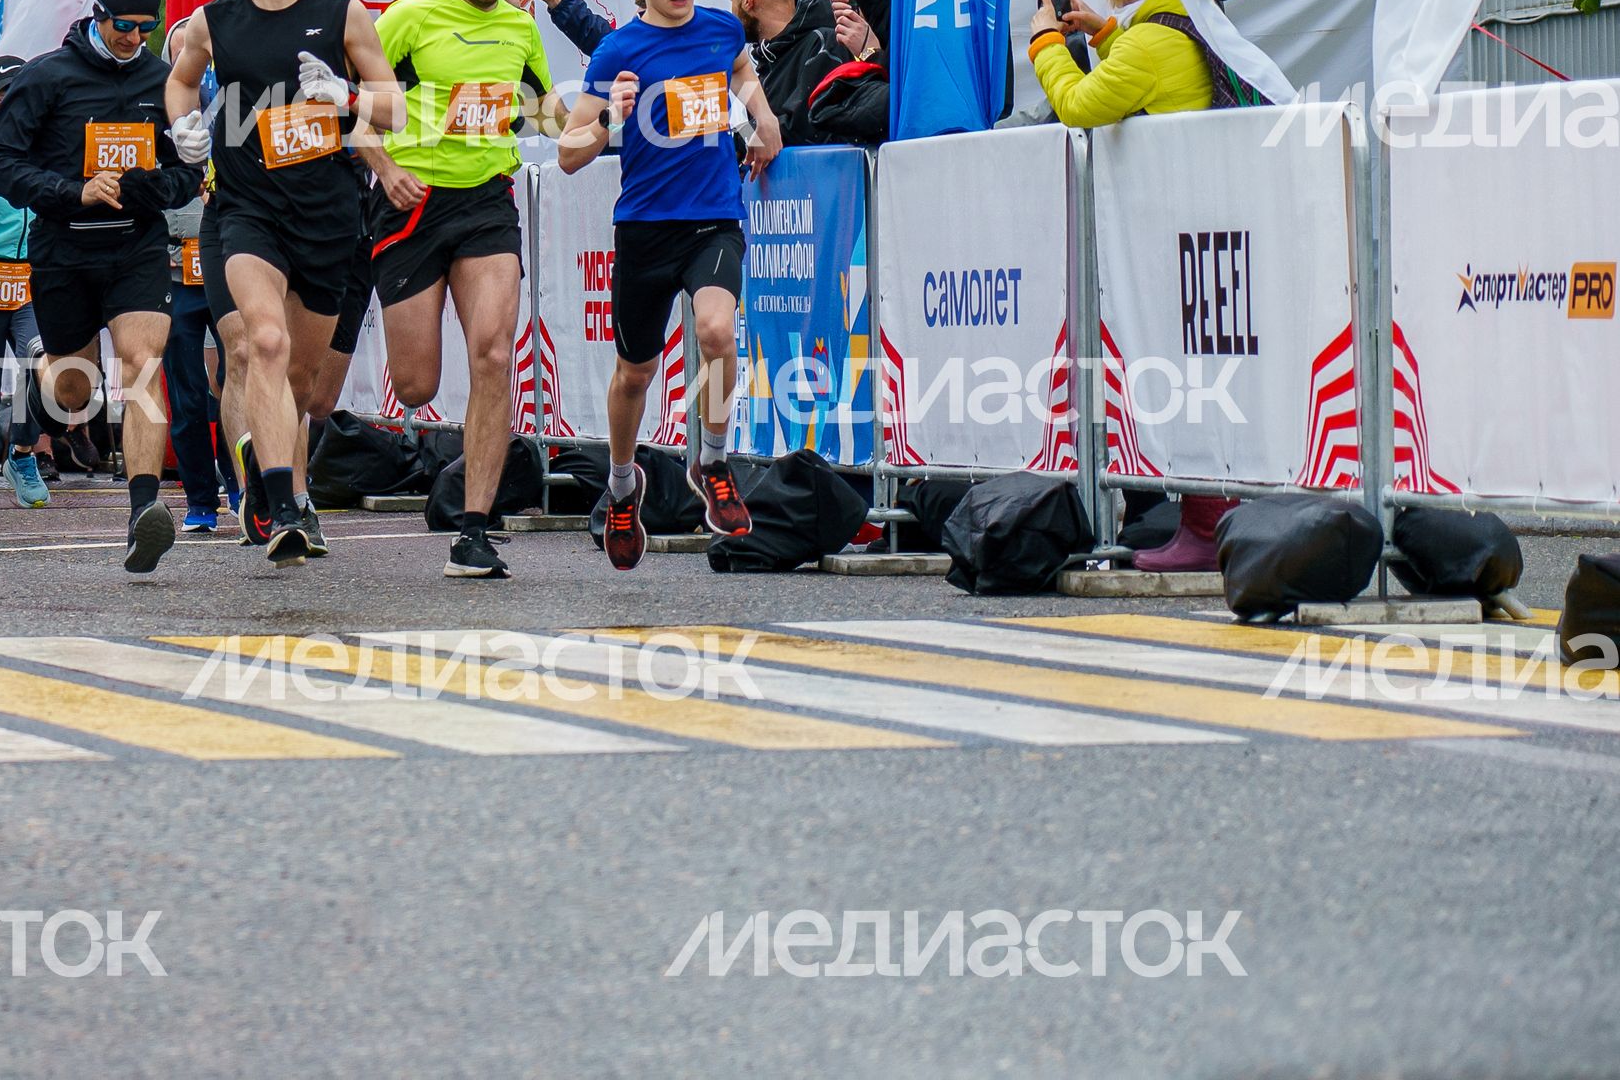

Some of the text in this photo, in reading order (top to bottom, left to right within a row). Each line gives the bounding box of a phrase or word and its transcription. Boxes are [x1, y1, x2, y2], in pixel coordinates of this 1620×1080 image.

[455, 104, 497, 127] 5094
[681, 95, 721, 127] 5215
[97, 144, 137, 168] 5218
[273, 122, 324, 156] 5250
[749, 193, 814, 235] КОЛОМЕНСКИЙ
[750, 240, 815, 286] ПОЛУМАРАФОН
[923, 268, 1022, 328] самолет
[1179, 231, 1259, 355] REEEL
[1572, 272, 1613, 309] PRO
